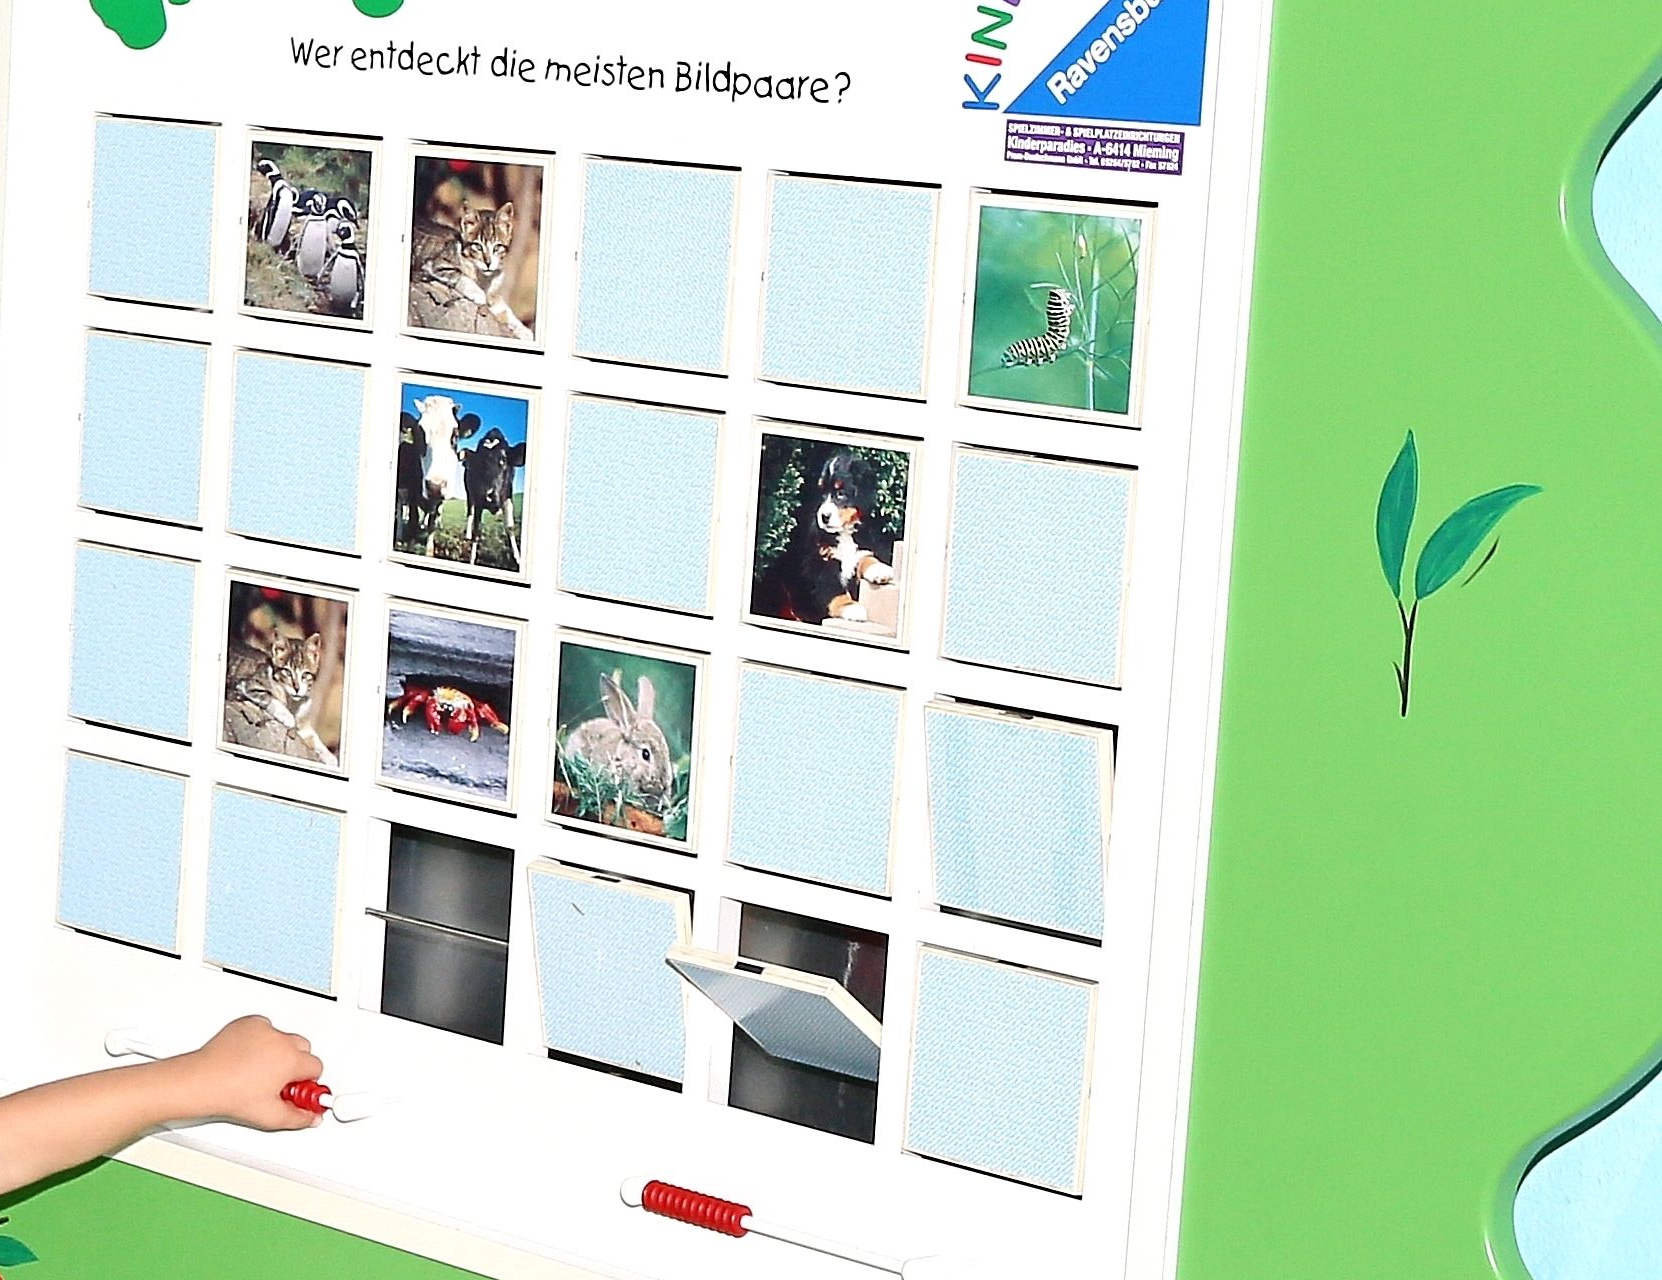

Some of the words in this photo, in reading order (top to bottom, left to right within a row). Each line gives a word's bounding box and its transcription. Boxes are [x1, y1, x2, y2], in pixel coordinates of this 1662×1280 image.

[290, 36, 343, 69] Wer
[350, 39, 481, 76] entdeckt
[491, 46, 536, 82] die
[544, 54, 665, 91] meisten
[675, 61, 851, 104] Bildpaare?
[1008, 135, 1086, 154] Kinderparadies
[1133, 144, 1180, 162] Mieming
